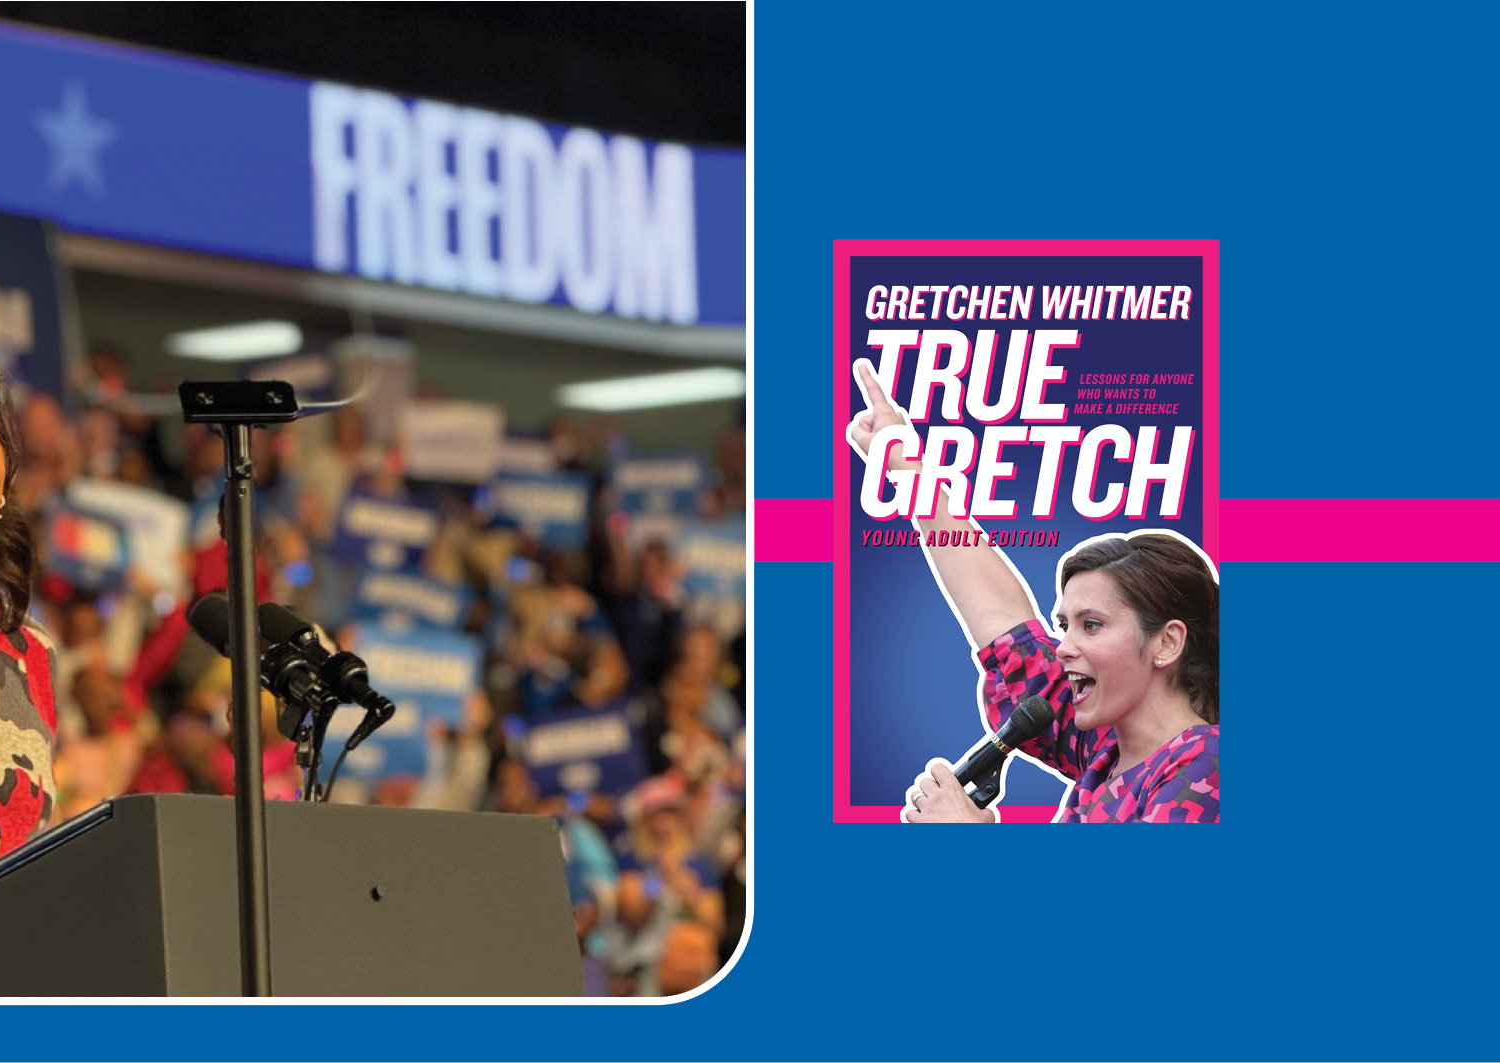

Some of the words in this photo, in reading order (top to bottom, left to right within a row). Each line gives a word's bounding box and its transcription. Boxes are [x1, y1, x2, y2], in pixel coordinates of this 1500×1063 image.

[309, 80, 698, 325] FREEDOM
[865, 285, 1034, 320] GRETCHEN
[1043, 285, 1193, 320] WHITMER
[867, 329, 1081, 424] TRUE
[1079, 373, 1126, 385] LESSONS
[1129, 373, 1149, 385] FOR
[1152, 373, 1194, 385] ANYONE
[1077, 388, 1101, 400] WHO
[1104, 388, 1140, 400] WANTS
[1143, 388, 1156, 400] TO
[1074, 403, 1103, 415] MAKE
[1105, 403, 1113, 415] A
[1115, 403, 1178, 415] DIFFERENCE
[860, 425, 1196, 519] GRETCH
[861, 529, 921, 547] YOUNG
[925, 529, 983, 547] ADULT
[987, 529, 1060, 547] EDITION
